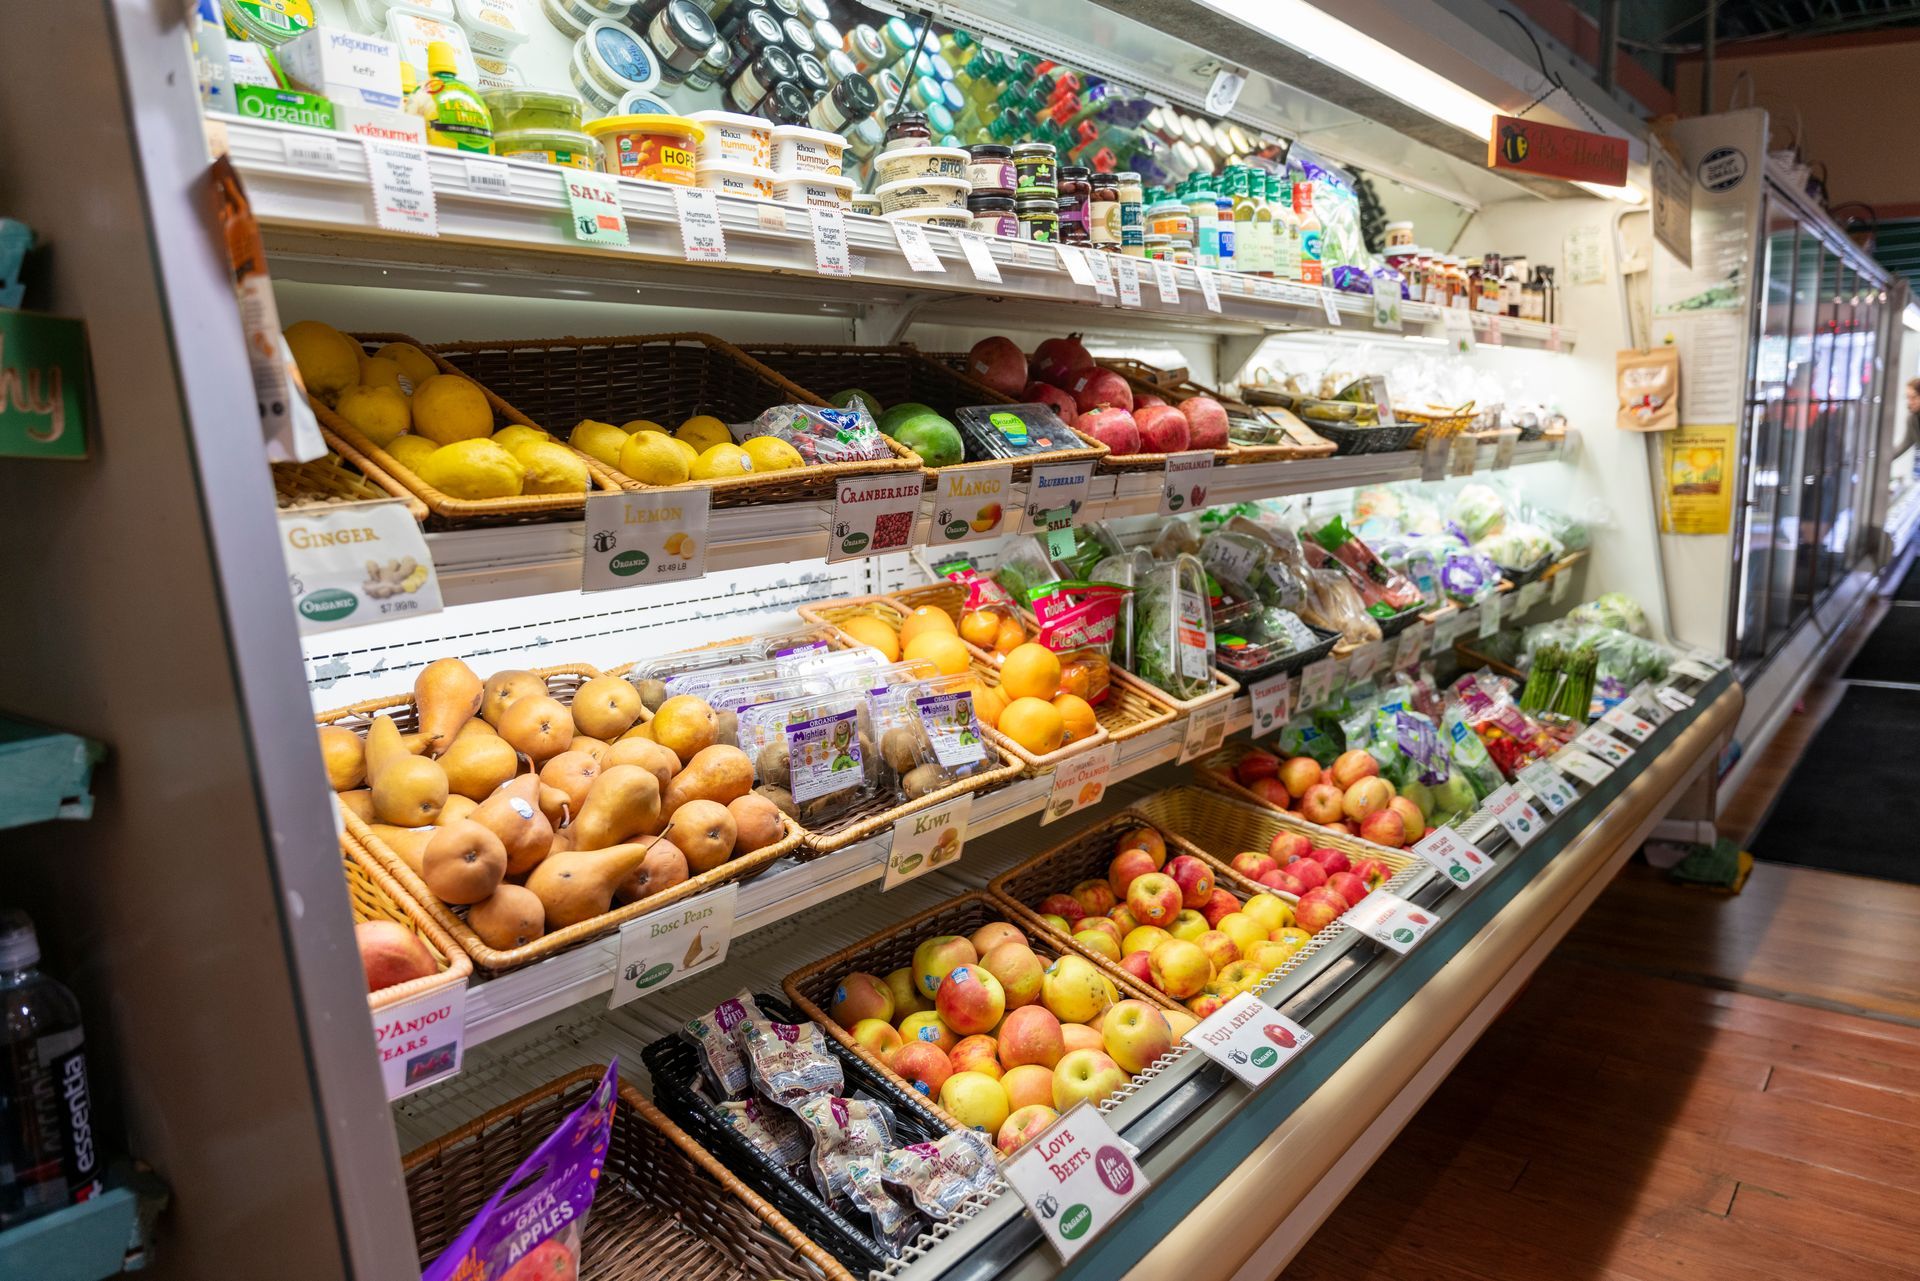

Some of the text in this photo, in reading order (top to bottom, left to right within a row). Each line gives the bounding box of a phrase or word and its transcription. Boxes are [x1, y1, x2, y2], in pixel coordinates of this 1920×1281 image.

[242, 95, 332, 128] Organic
[721, 128, 741, 140] ithaca
[721, 138, 756, 152] hummus
[796, 143, 815, 154] ithaca
[665, 149, 694, 168] HOPE
[796, 153, 829, 166] hummus
[723, 178, 743, 189] ithaca
[570, 184, 616, 205] SALE
[685, 191, 702, 199] Hope
[807, 187, 826, 198] ithaca
[806, 196, 840, 209] hummus
[685, 211, 711, 219] Hummus
[820, 238, 841, 246] Hummus
[948, 475, 1001, 498] MANGO
[1038, 475, 1085, 489] BLUEBERRIES
[840, 485, 920, 504] CRANBERRIES
[624, 503, 684, 526] LEMON
[1048, 518, 1072, 532] SALE
[288, 526, 380, 550] GINGER
[611, 556, 647, 571] ORGANIC
[657, 562, 688, 574] $3.49 LB
[301, 596, 355, 614] ORGANIC
[932, 693, 958, 703] ORGANIC
[921, 704, 949, 715] Mighties
[808, 715, 837, 728] ORGANIC
[792, 728, 826, 742] Mighties
[912, 812, 952, 837] KIWI
[1202, 1002, 1263, 1046] FUJI APPLES
[378, 1035, 429, 1062] EARS
[1253, 1049, 1275, 1068] ORGANIC
[63, 1054, 94, 1174] essentia
[1034, 1128, 1074, 1163] LOVE
[1048, 1146, 1092, 1184] BEETS
[515, 1193, 557, 1231] GALA
[1060, 1207, 1089, 1234] ORGANIC
[508, 1200, 574, 1263] APPLES
